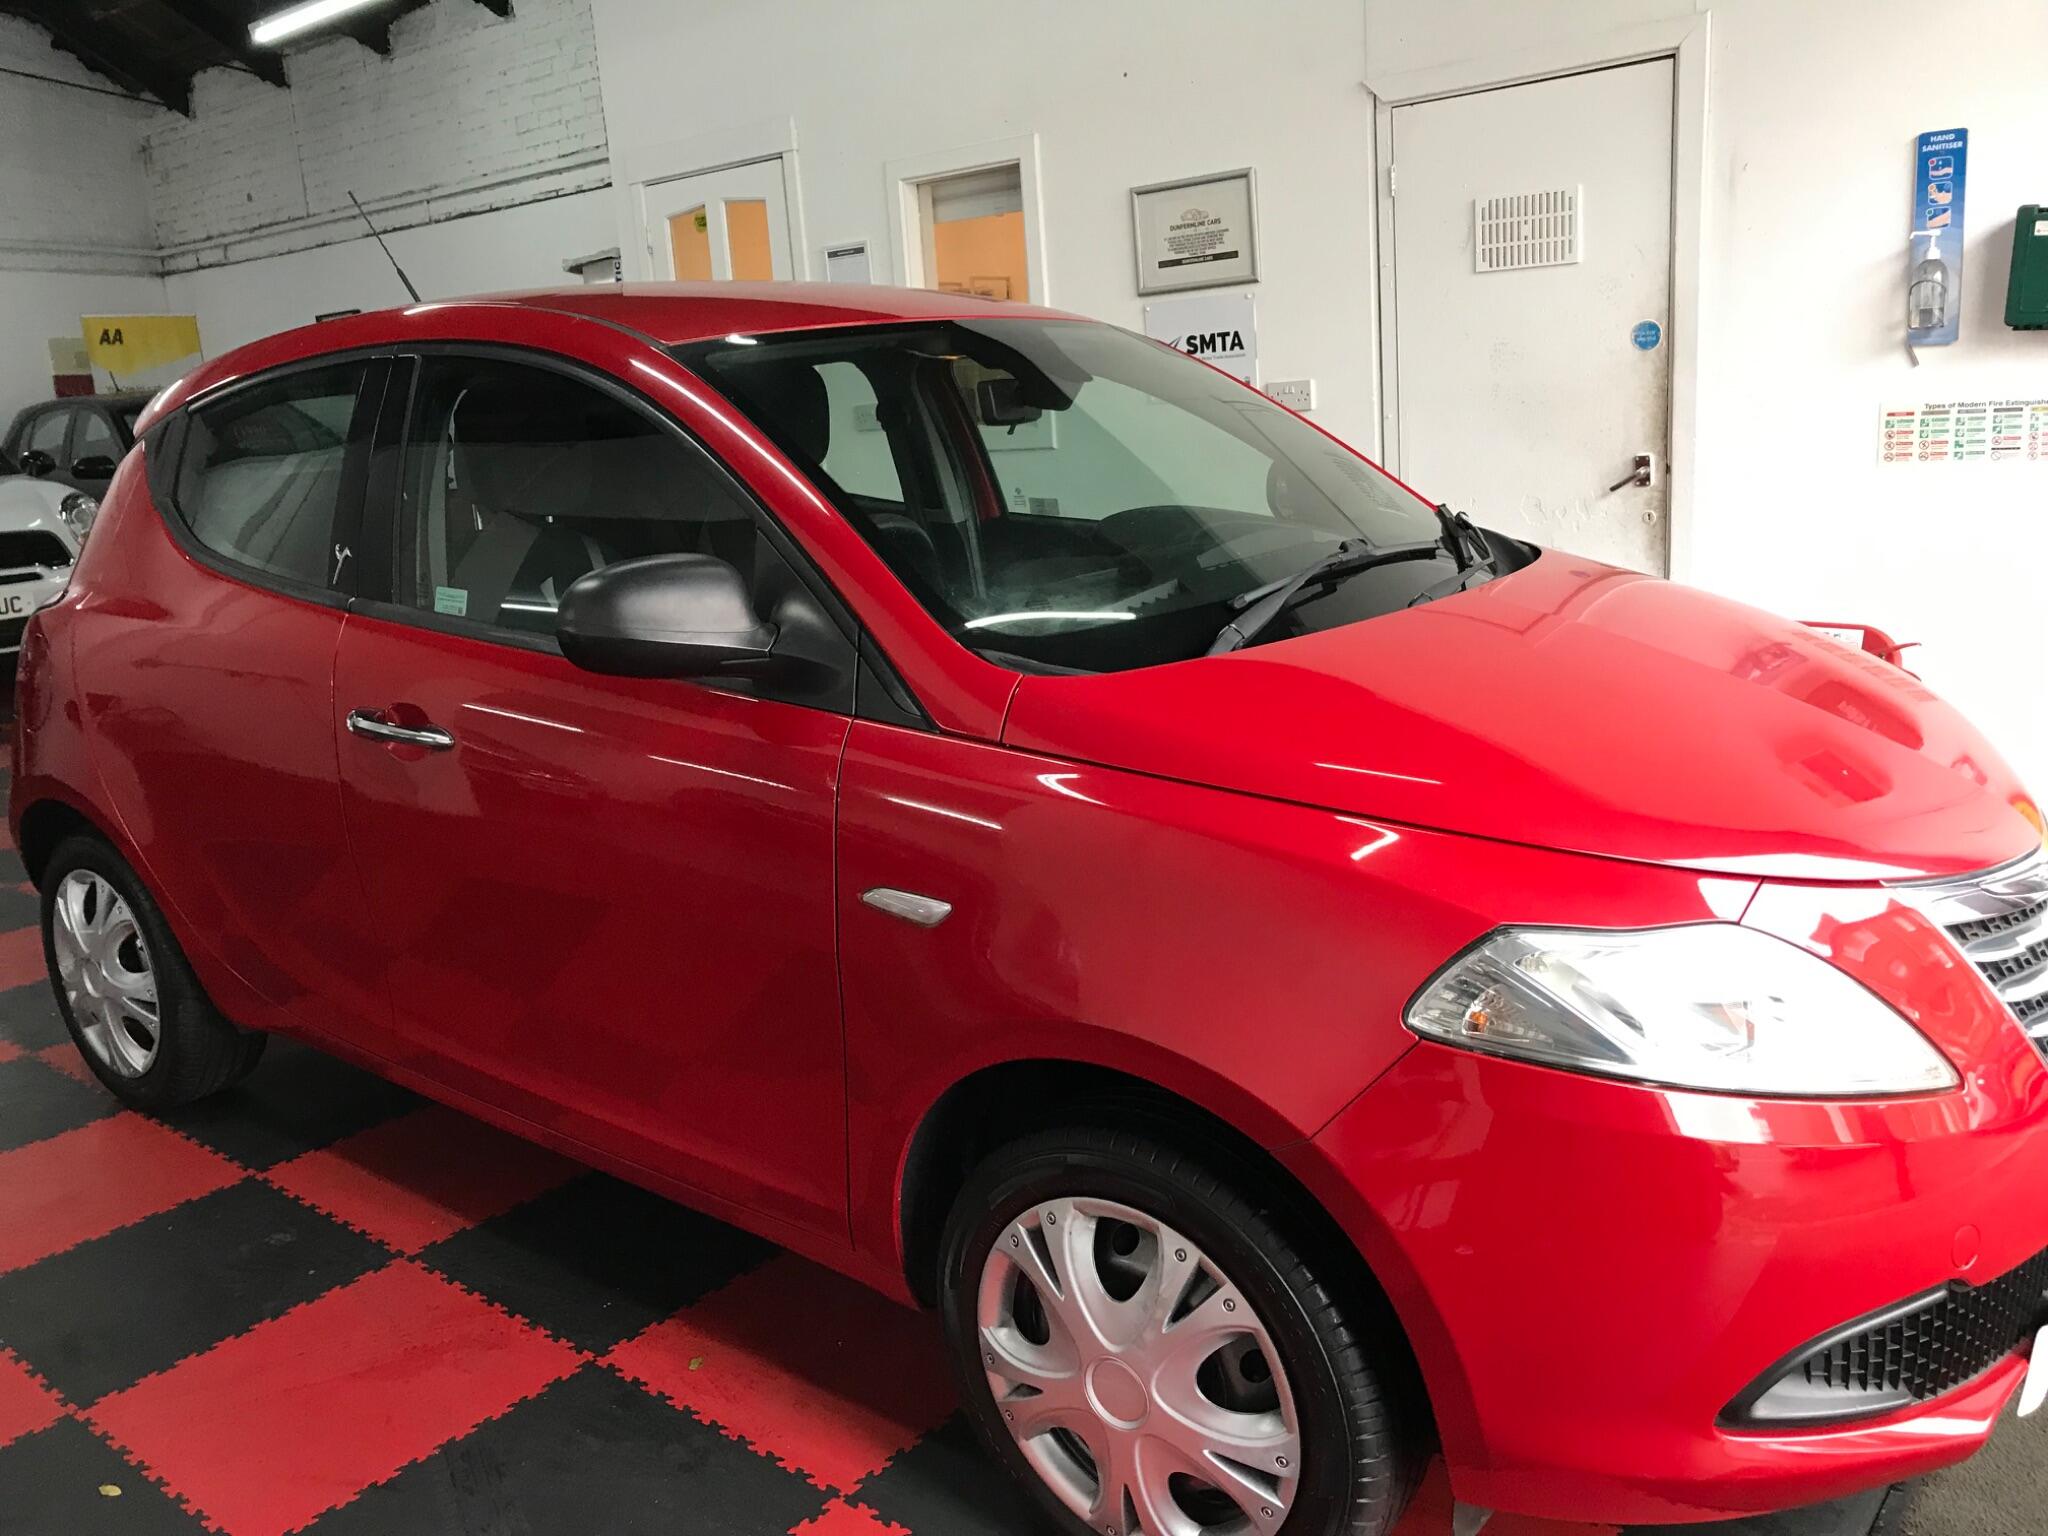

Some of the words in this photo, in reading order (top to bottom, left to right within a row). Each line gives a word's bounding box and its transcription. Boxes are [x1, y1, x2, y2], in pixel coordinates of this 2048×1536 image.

[1930, 133, 1955, 143] HAND
[1922, 141, 1963, 152] SANITISER
[1207, 217, 1222, 226] CARS
[99, 328, 123, 345] AA
[1186, 330, 1244, 355] SMTA
